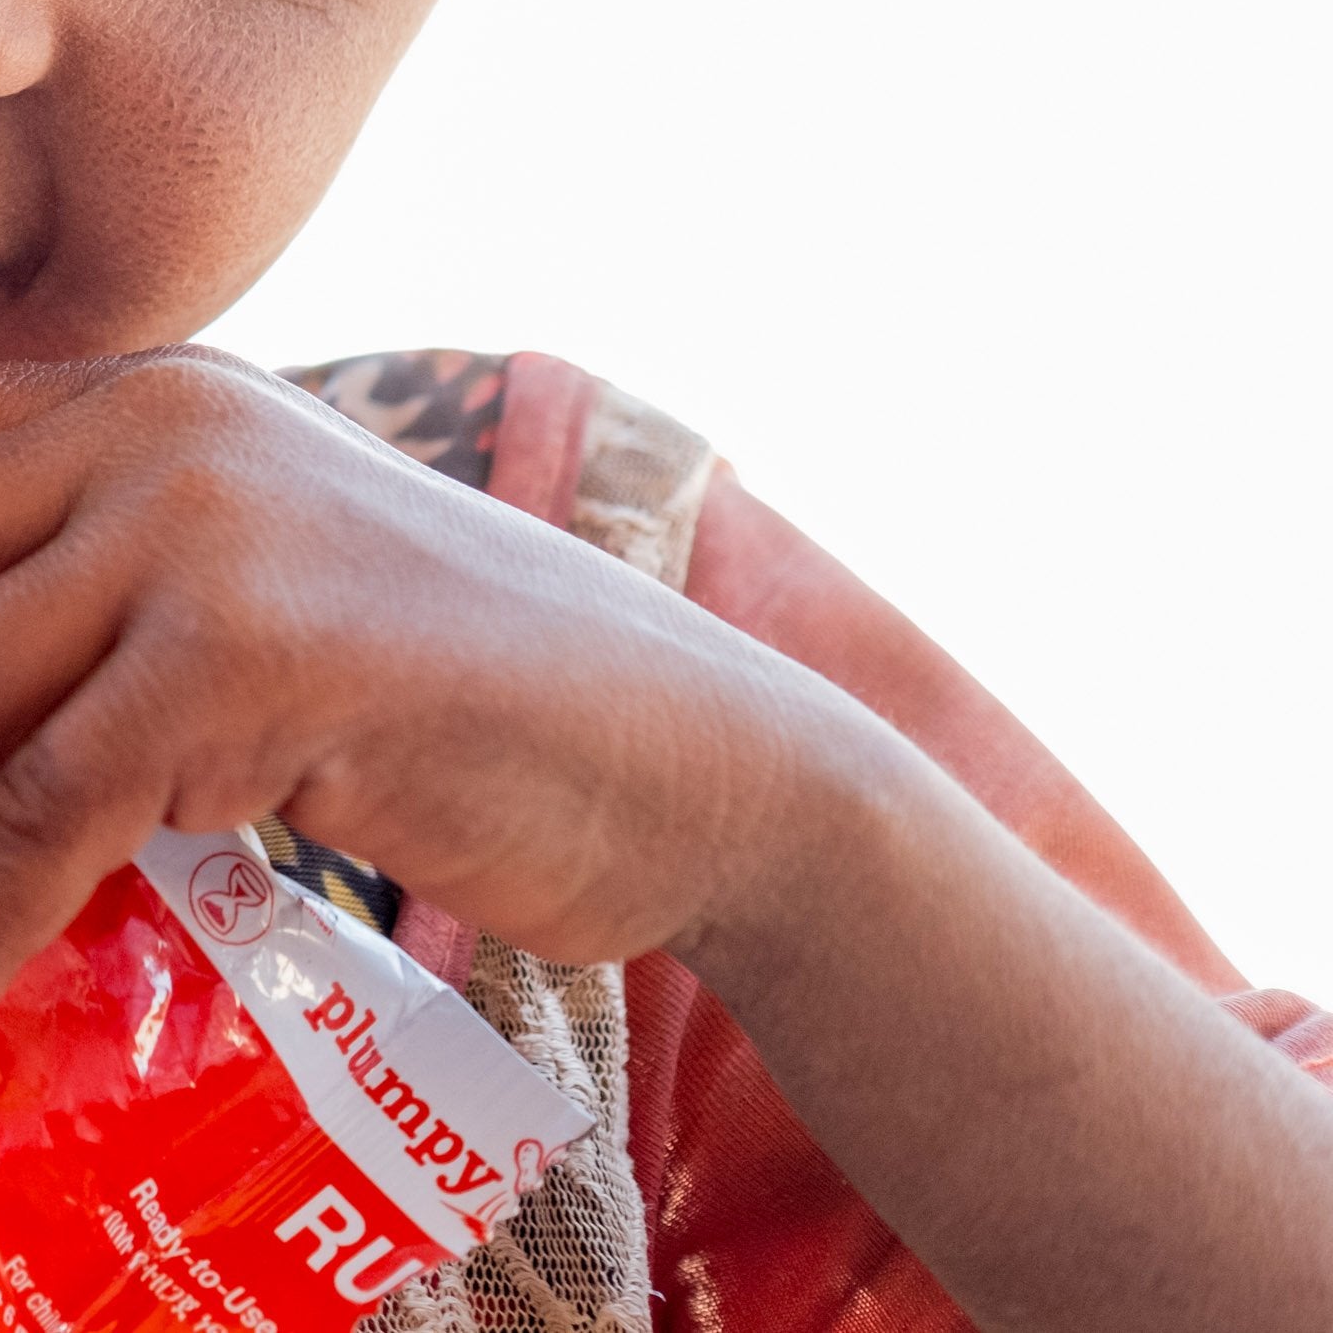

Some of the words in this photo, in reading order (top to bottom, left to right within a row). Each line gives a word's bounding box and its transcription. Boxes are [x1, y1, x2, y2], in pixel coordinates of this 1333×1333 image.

[303, 981, 503, 1195] plumpy
[4, 1254, 35, 1293] For
[274, 1183, 425, 1305] RU
